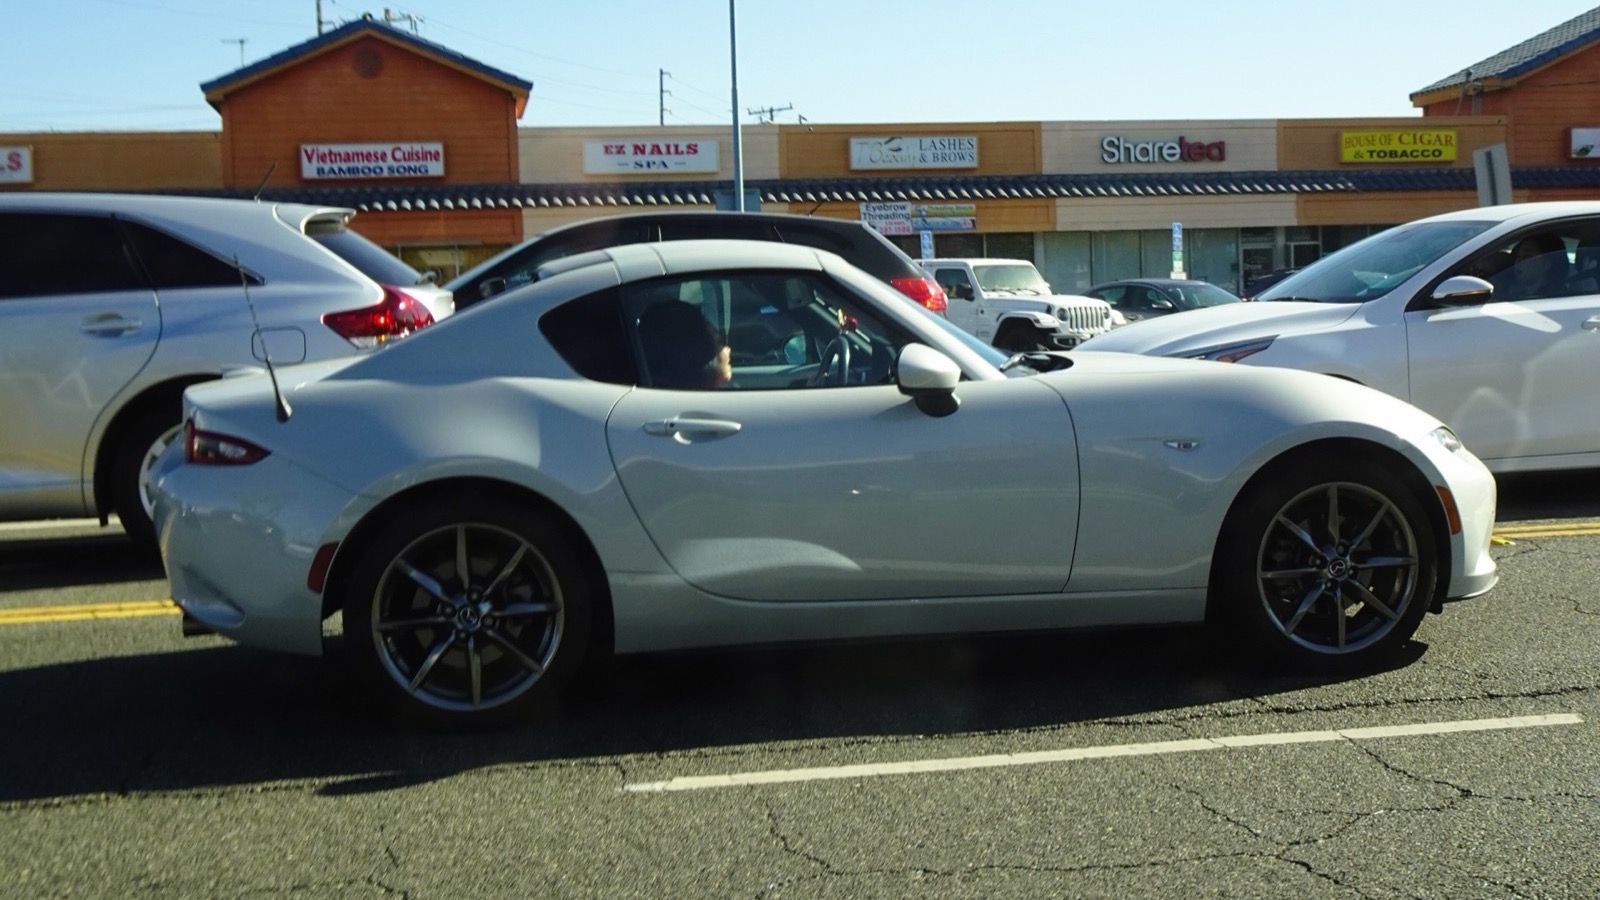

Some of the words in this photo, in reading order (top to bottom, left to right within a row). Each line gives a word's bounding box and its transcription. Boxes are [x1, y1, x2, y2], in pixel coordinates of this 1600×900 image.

[919, 138, 975, 152] LASHES
[1344, 134, 1376, 149] HOUSE
[1379, 133, 1393, 146] OF
[1398, 132, 1454, 147] CIGAR
[303, 147, 387, 164] Vietnamese
[391, 144, 440, 163] Cuisine
[603, 144, 626, 155] EZ
[632, 143, 699, 156] NAILS
[1101, 135, 1226, 164] Sharetea
[1353, 150, 1364, 159] &
[1367, 148, 1442, 159] TOBACCO
[919, 152, 928, 163] &
[932, 151, 975, 163] BROWS
[316, 164, 384, 177] BAMBOO
[387, 164, 430, 175] SONG
[633, 160, 670, 169] SPA
[865, 203, 907, 212] Eyebrow
[862, 211, 912, 220] Threading
